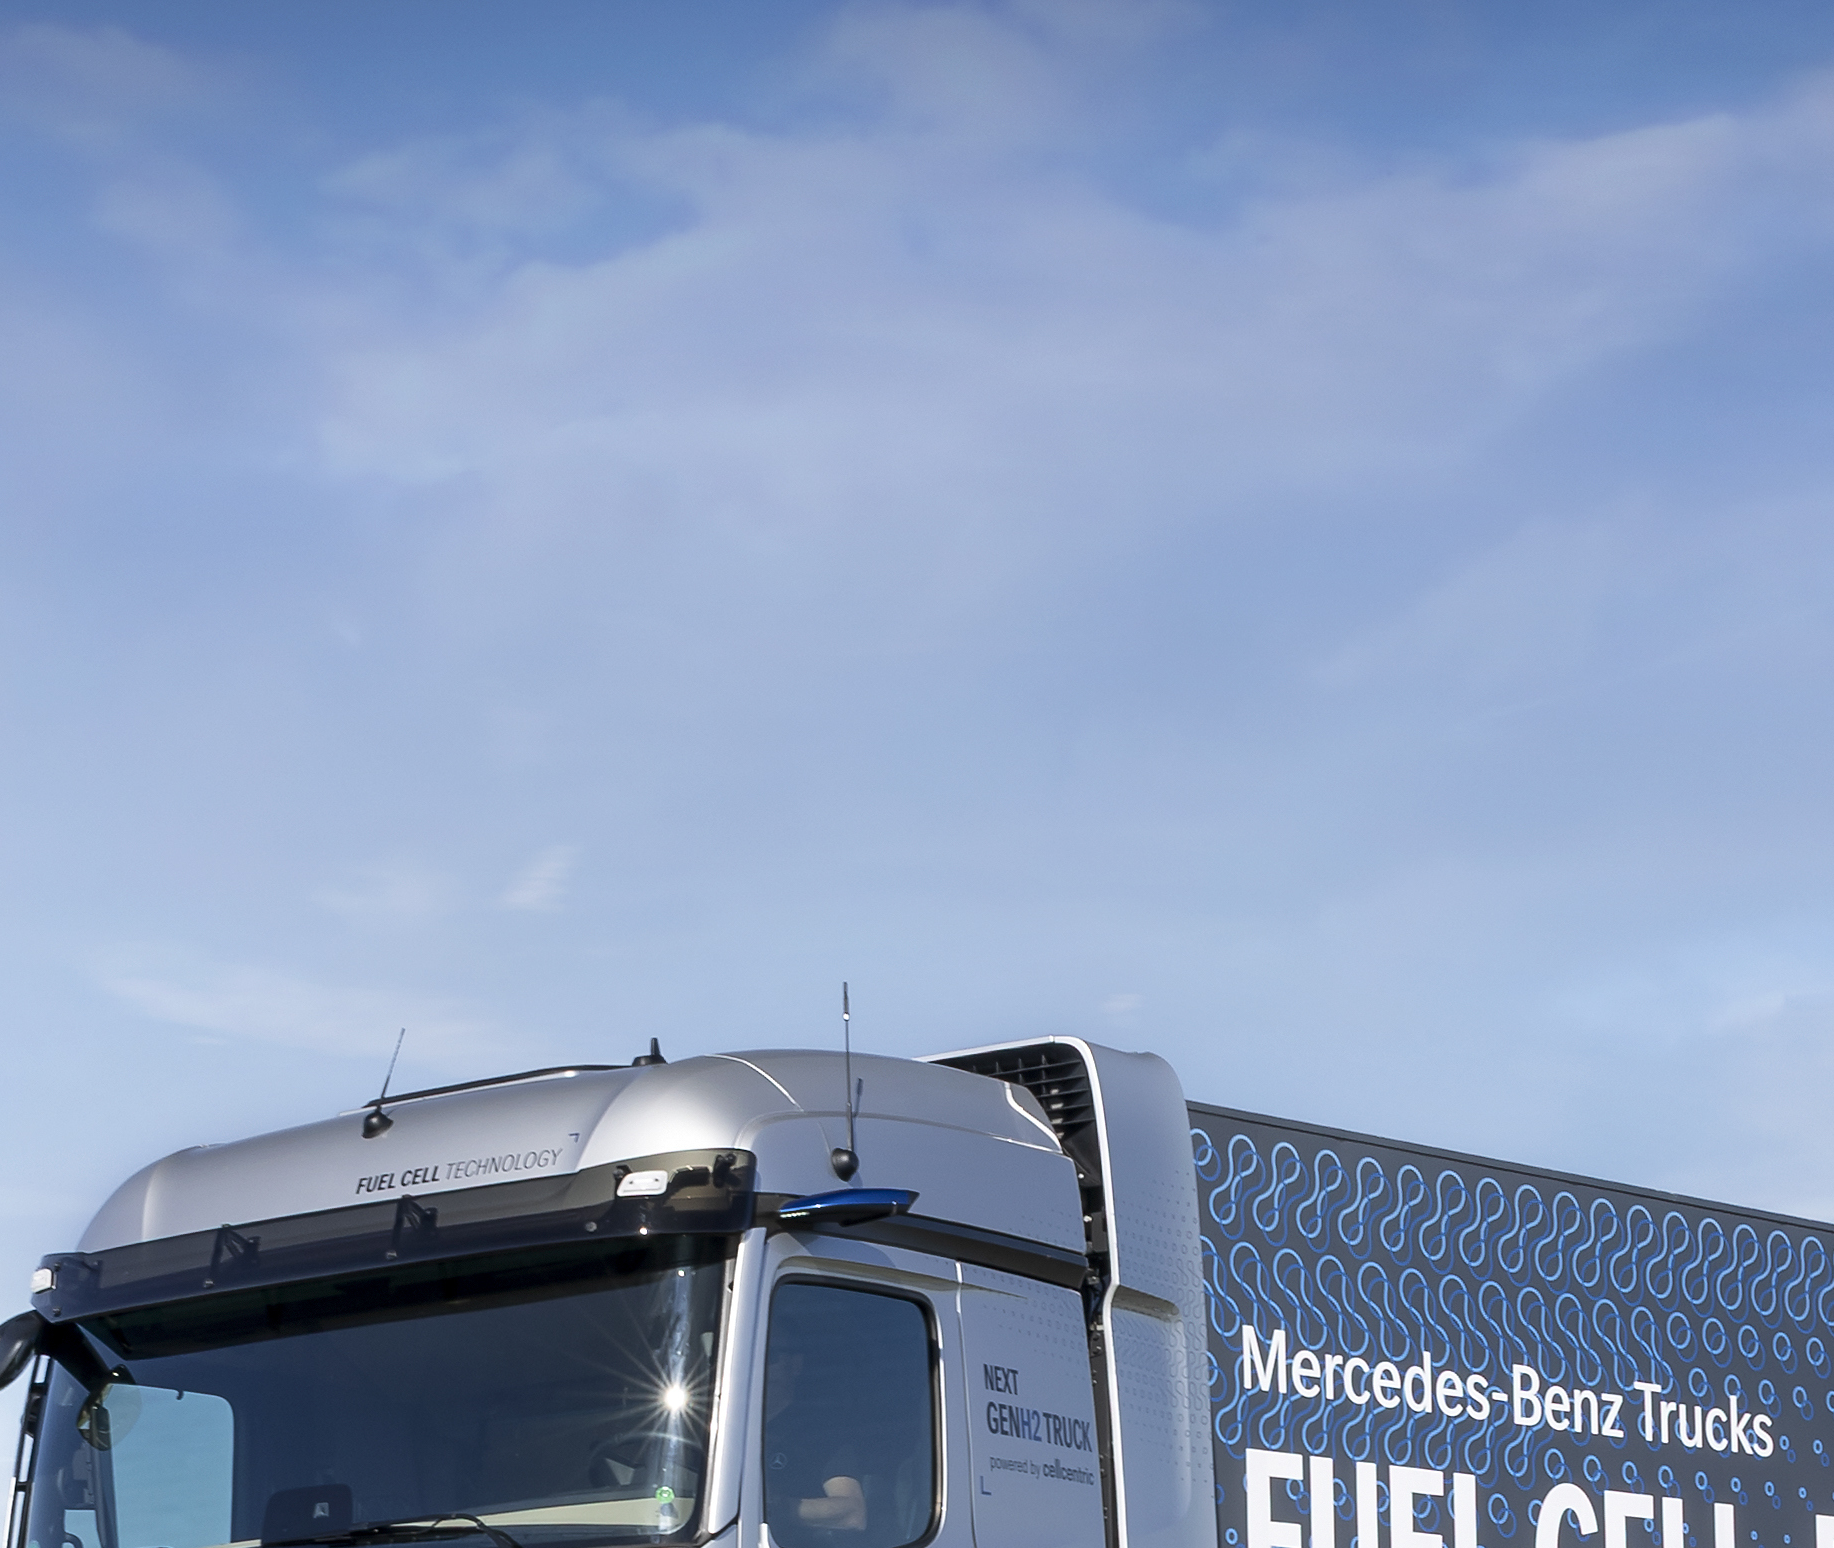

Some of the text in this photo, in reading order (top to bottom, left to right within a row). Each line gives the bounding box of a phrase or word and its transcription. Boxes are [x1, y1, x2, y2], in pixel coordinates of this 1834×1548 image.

[355, 1148, 563, 1194] FUEL CELL TECHNOLOGY
[983, 1363, 1019, 1395] NEXT
[1241, 1324, 1774, 1458] Mercedes-Benz Trucks
[986, 1401, 1093, 1453] GENH2 TRUCK
[990, 1456, 1095, 1486] powered by cellcentric
